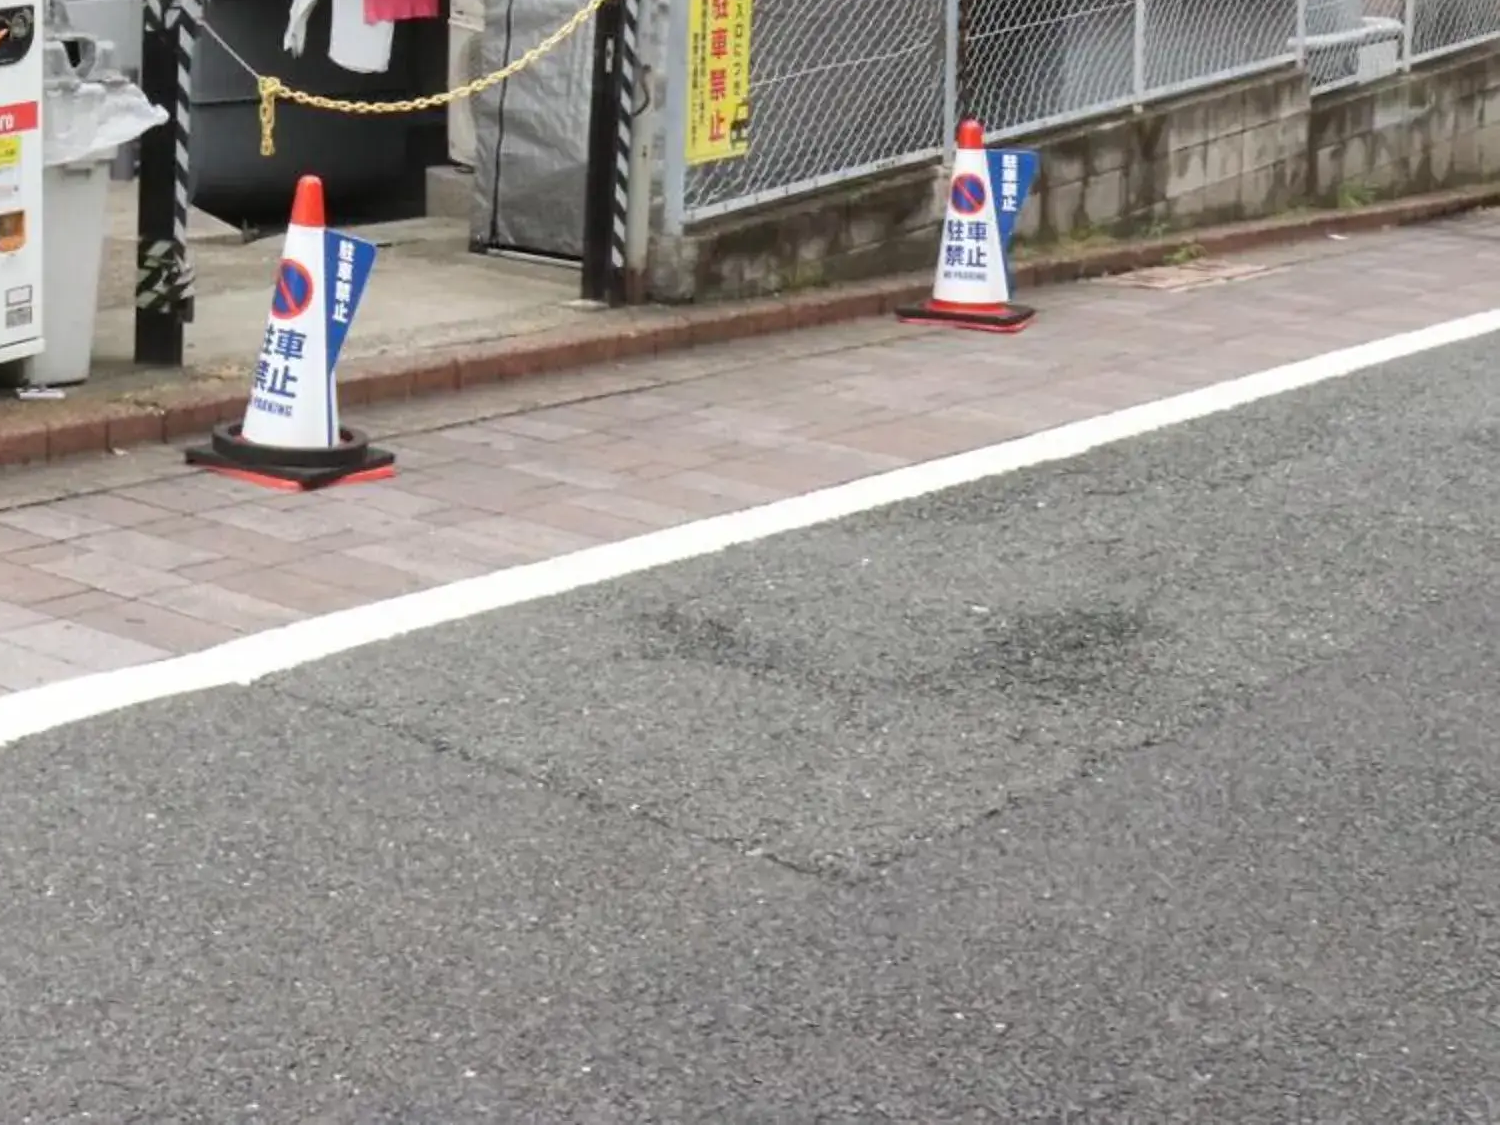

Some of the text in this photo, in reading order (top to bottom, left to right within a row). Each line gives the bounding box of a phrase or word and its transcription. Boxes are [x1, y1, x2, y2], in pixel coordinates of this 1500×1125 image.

[1002, 154, 1018, 212] 駐車禁止
[947, 220, 988, 242] 駐車
[945, 244, 987, 268] 禁止
[333, 241, 355, 322] 駐車禁止
